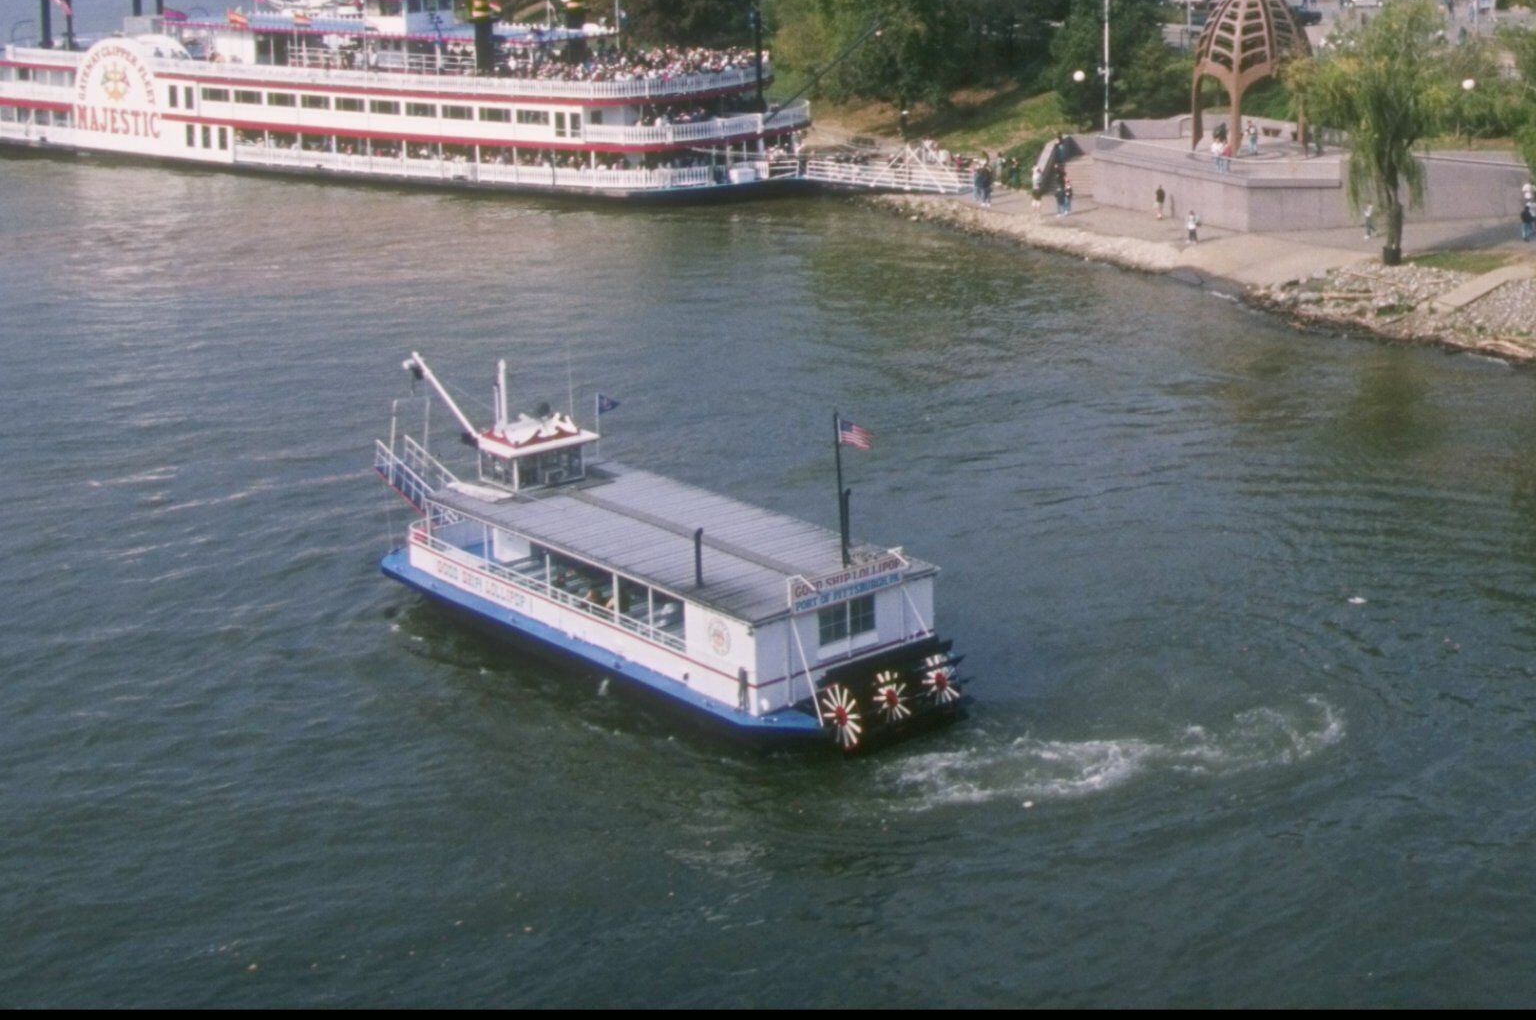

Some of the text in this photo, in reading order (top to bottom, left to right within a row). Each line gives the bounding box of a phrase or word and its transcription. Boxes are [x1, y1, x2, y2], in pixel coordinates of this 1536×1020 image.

[78, 45, 156, 105] GATEWAY CLIPPER FLEET
[77, 103, 161, 139] MAJESTIC
[826, 572, 851, 587] SHIP
[853, 557, 902, 580] LOLLIPOP
[794, 596, 818, 612] PORT
[819, 592, 830, 605] OF
